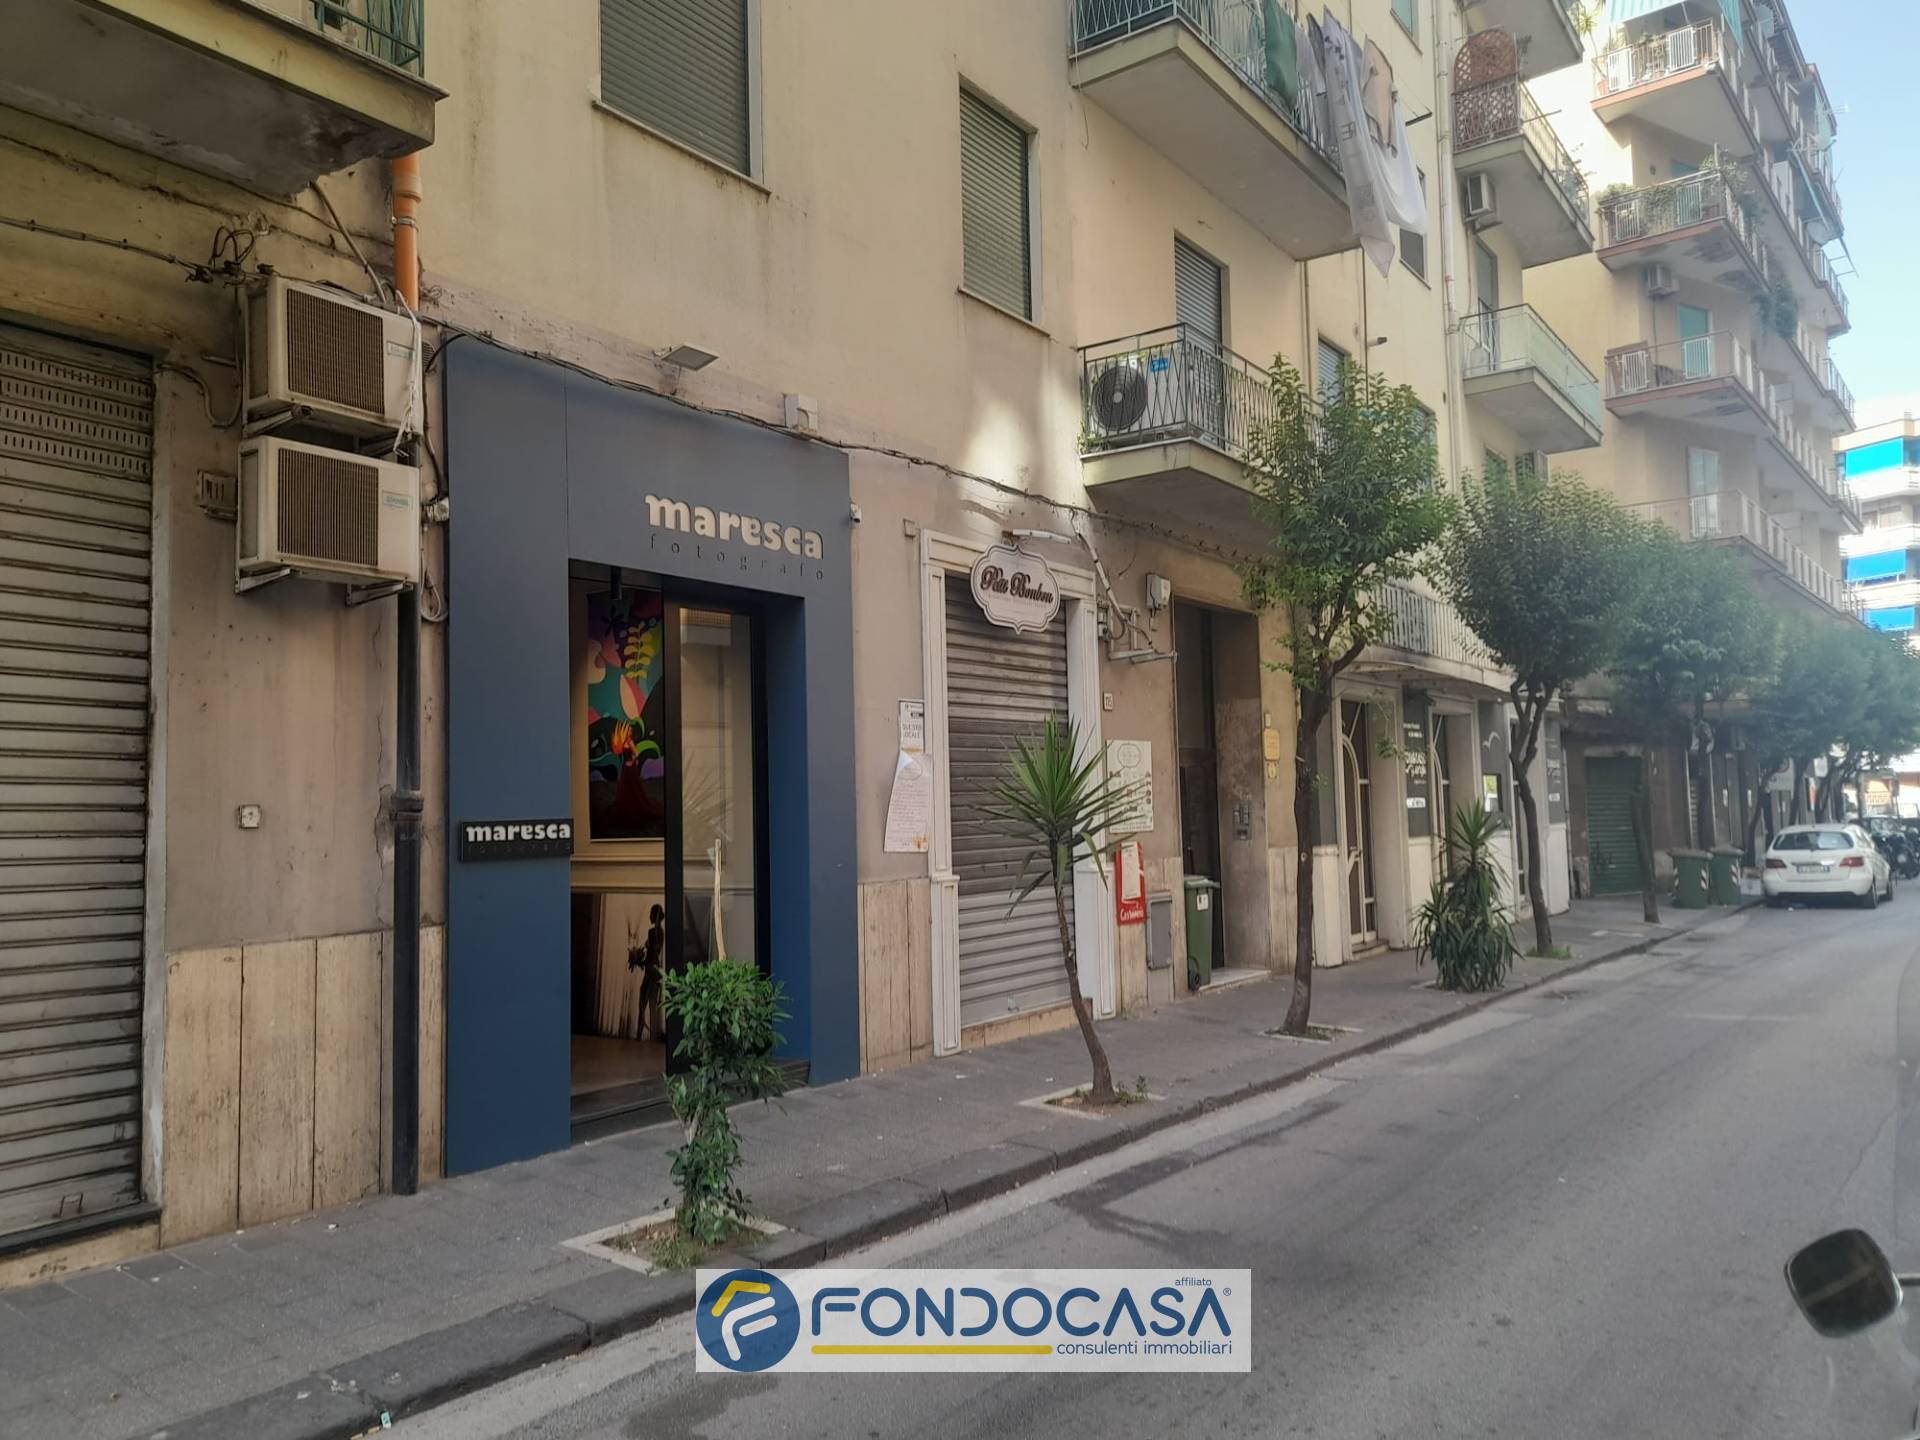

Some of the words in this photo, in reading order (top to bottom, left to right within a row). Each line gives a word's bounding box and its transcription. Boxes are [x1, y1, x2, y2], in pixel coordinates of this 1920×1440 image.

[645, 494, 823, 560] maresca
[651, 534, 823, 580] fotografo
[466, 823, 571, 842] maresca
